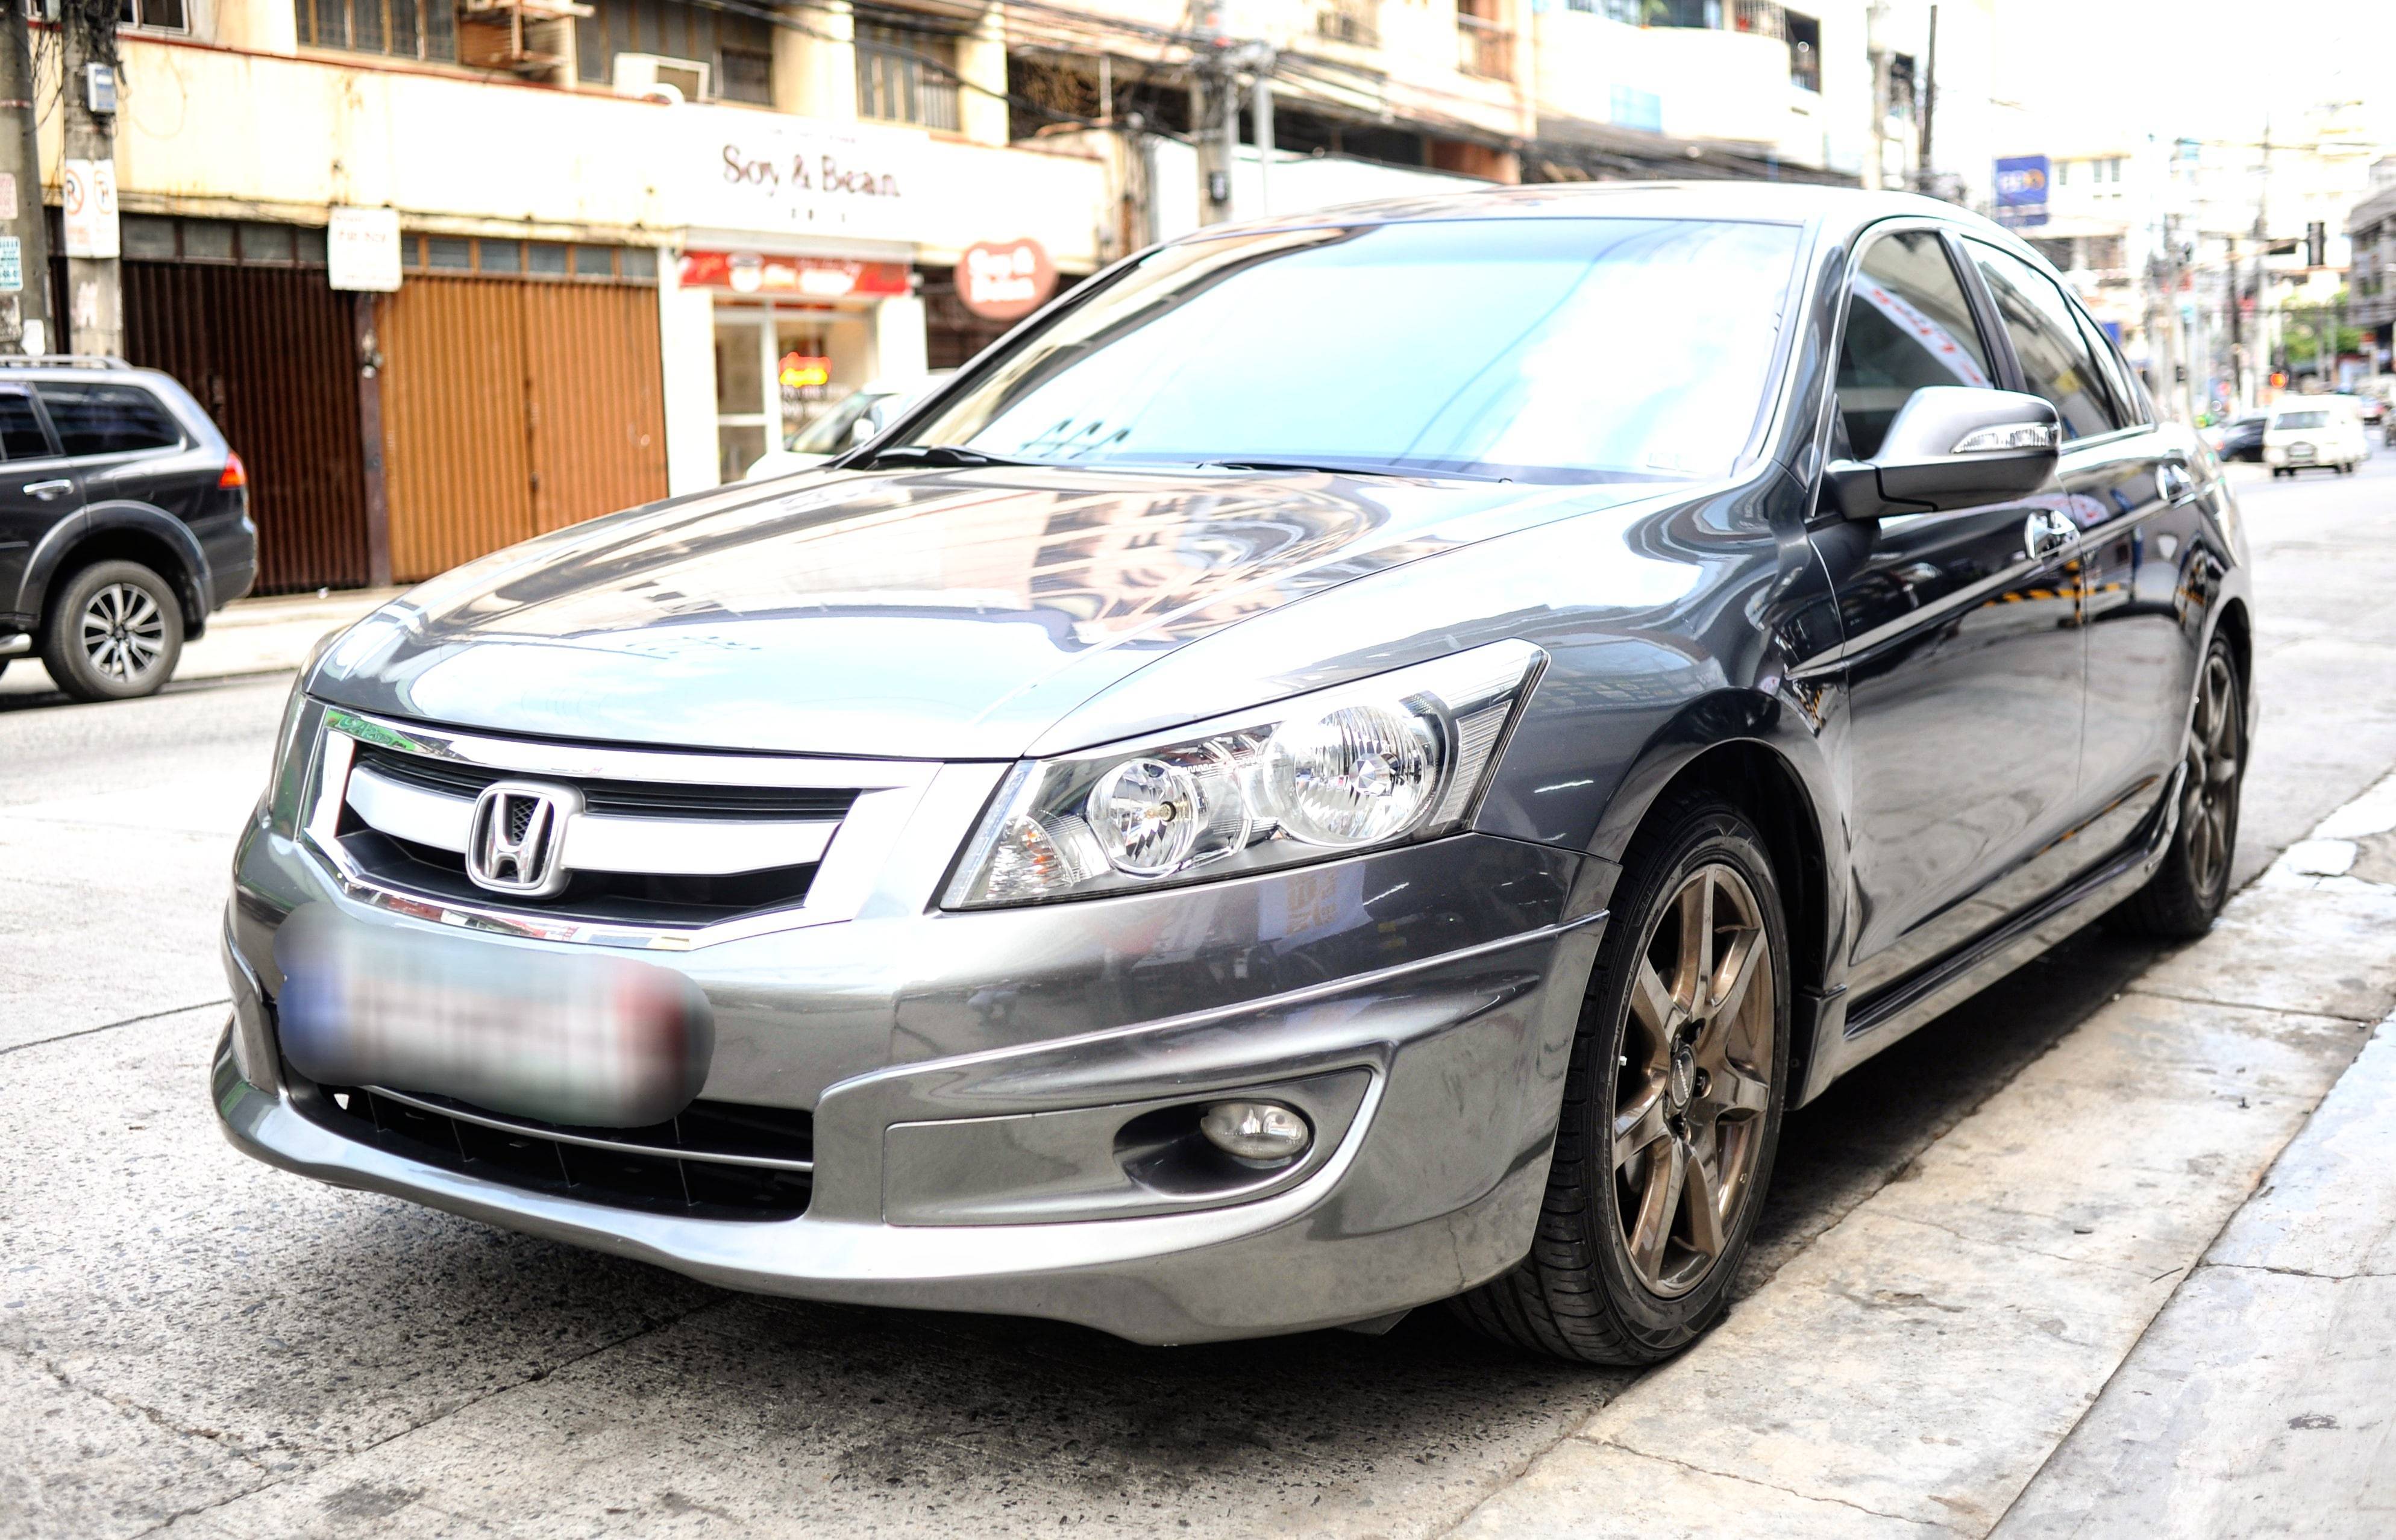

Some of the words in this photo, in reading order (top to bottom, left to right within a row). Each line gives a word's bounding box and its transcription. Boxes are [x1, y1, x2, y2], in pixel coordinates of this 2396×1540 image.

[723, 143, 779, 198] Soy
[791, 154, 812, 190] &
[822, 154, 902, 198] Bean
